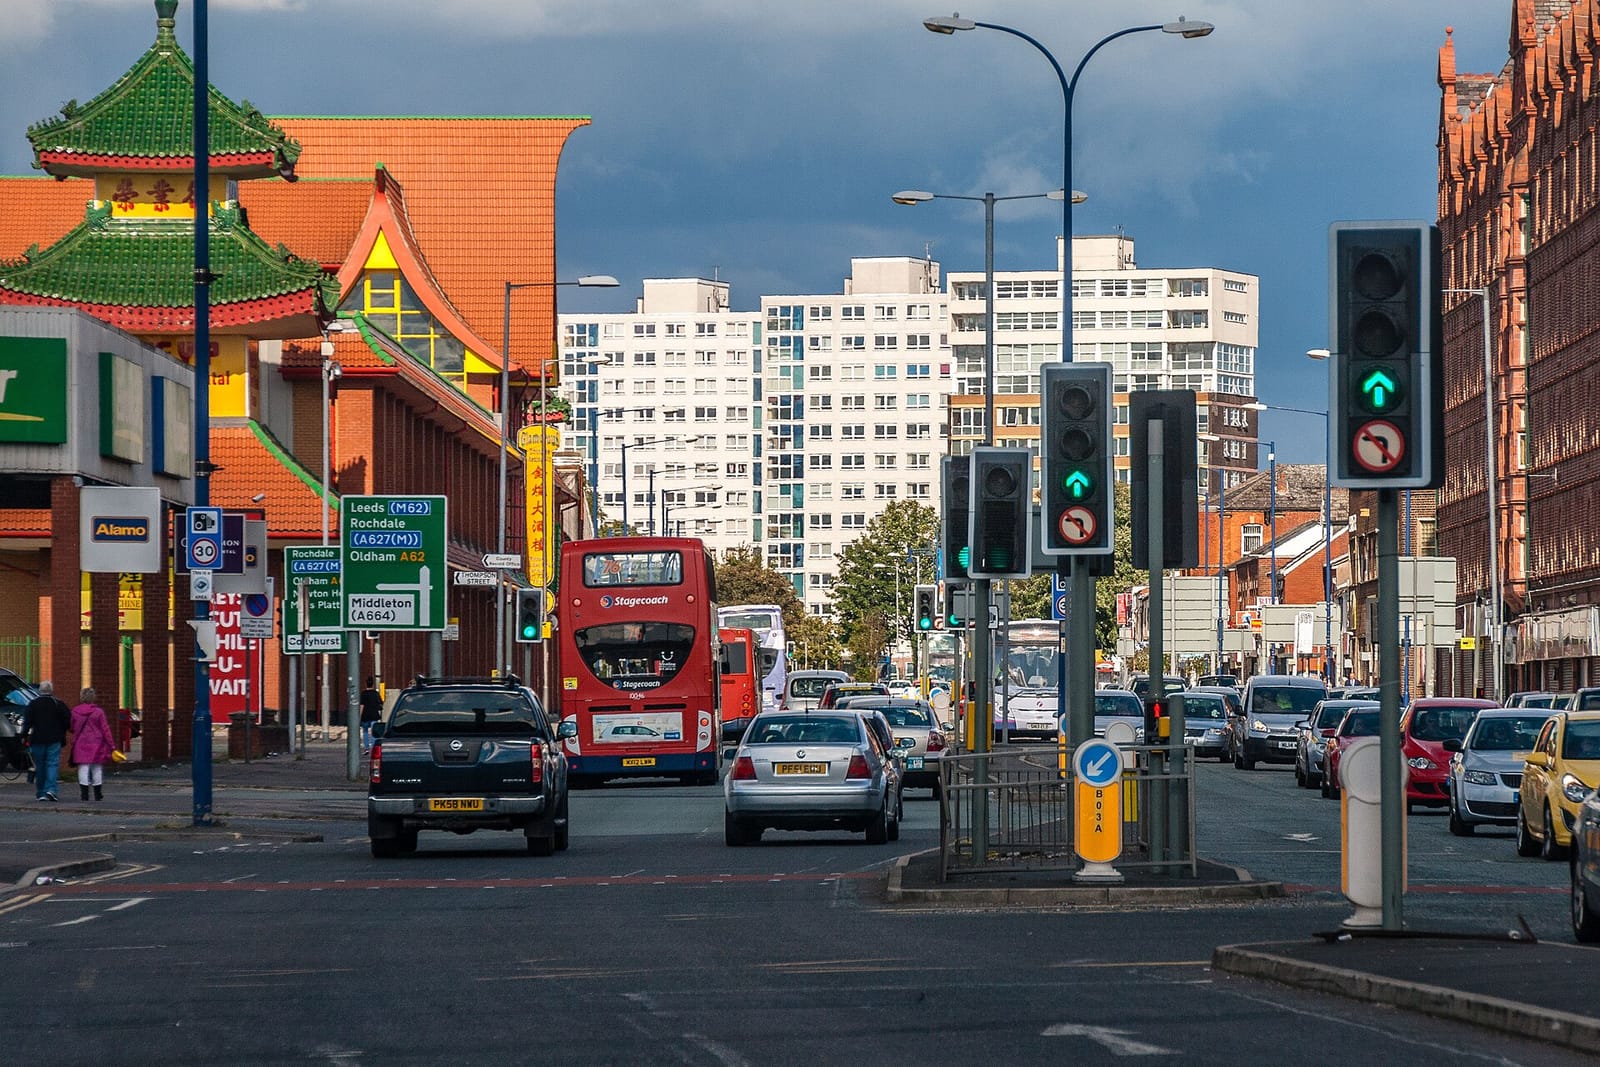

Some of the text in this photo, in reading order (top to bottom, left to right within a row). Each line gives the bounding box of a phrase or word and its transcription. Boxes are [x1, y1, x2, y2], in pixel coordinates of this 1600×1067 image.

[350, 502, 429, 514] Leeds (M62)
[350, 518, 406, 529] Rochdale
[95, 524, 146, 536] Alamo
[353, 533, 419, 546] (A627(M))
[195, 546, 214, 557] 30
[292, 550, 334, 558] Rochdale
[350, 551, 425, 562] Oldham A62
[602, 560, 621, 574] 76
[317, 600, 341, 609] Platt
[351, 599, 412, 608] Middleton
[614, 596, 668, 607] Stagecoach
[351, 611, 396, 621] (A664)
[622, 681, 660, 689] Stagecoach
[434, 800, 458, 809] PK58
